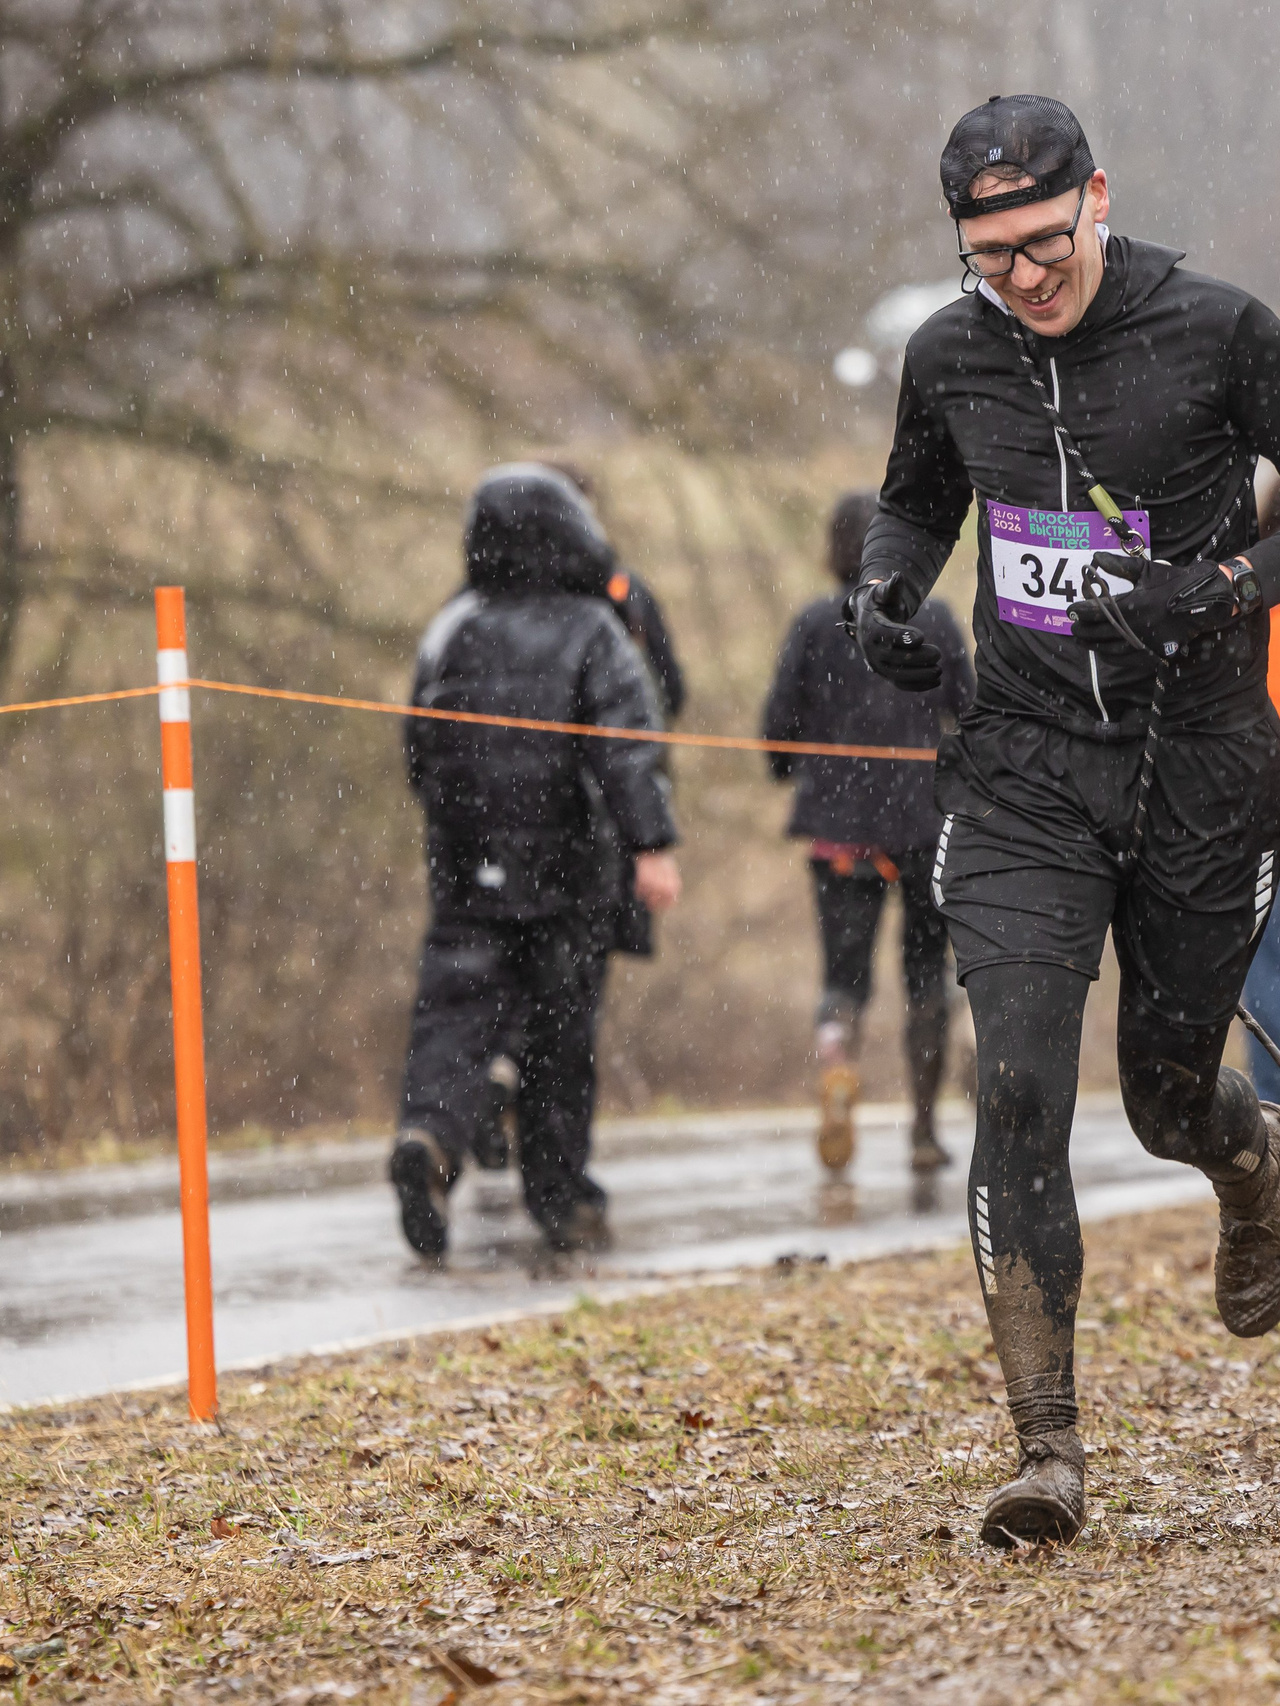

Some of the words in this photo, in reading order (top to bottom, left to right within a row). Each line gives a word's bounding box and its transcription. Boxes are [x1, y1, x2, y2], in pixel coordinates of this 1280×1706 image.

[993, 508, 1021, 522] 11/04
[1028, 511, 1075, 525] КРОСС
[994, 518, 1022, 533] 2026
[1029, 522, 1090, 538] БЫСТРЫЙ
